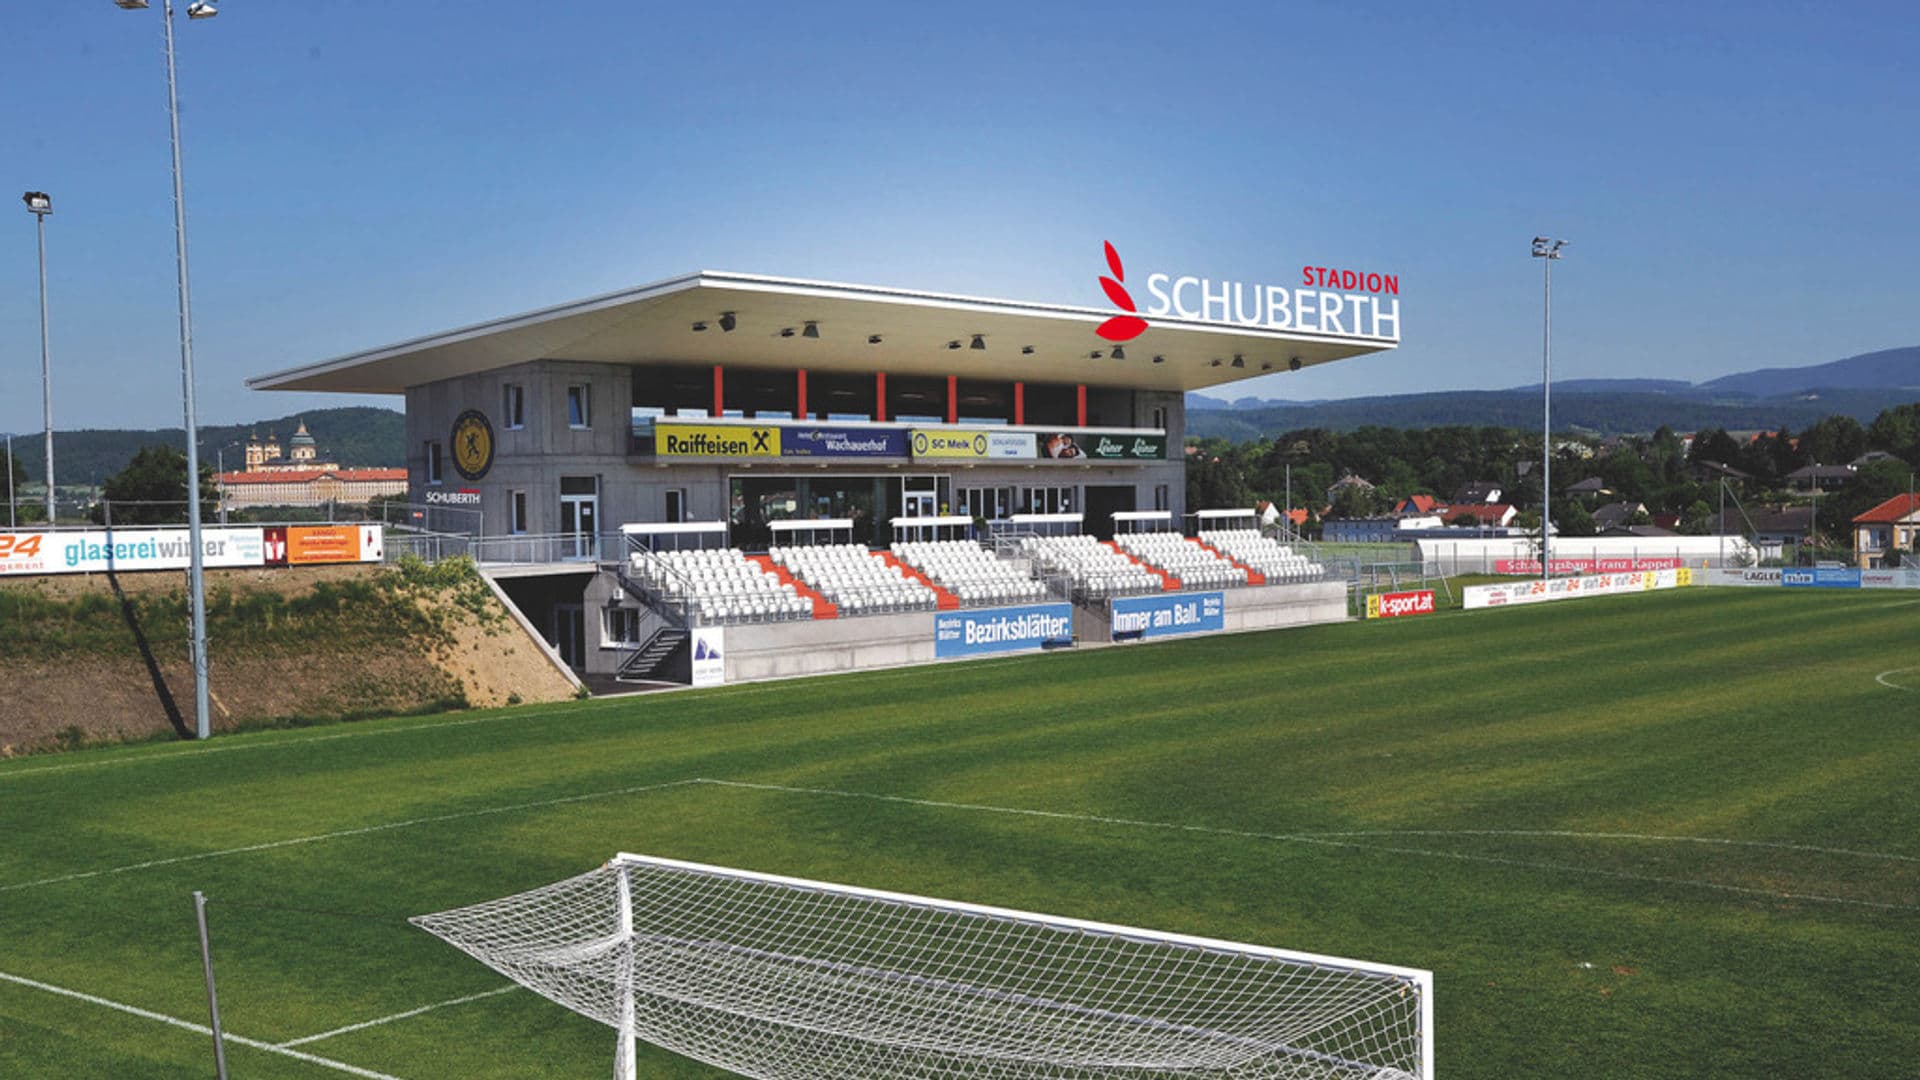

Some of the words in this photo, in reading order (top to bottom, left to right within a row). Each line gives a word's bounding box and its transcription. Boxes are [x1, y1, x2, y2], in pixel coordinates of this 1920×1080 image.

[1302, 266, 1399, 295] STADION
[1147, 273, 1400, 341] SCHUBERTH
[667, 434, 749, 454] Raiffeisen
[425, 491, 481, 504] SCHUBERTH
[1595, 560, 1627, 570] Franz
[1631, 559, 1675, 570] Kappel
[1743, 571, 1782, 581] LAGLER
[1379, 593, 1434, 616] k-sport.at
[1112, 608, 1152, 632] Immer
[1152, 609, 1173, 628] am
[1174, 602, 1202, 626] Ball.
